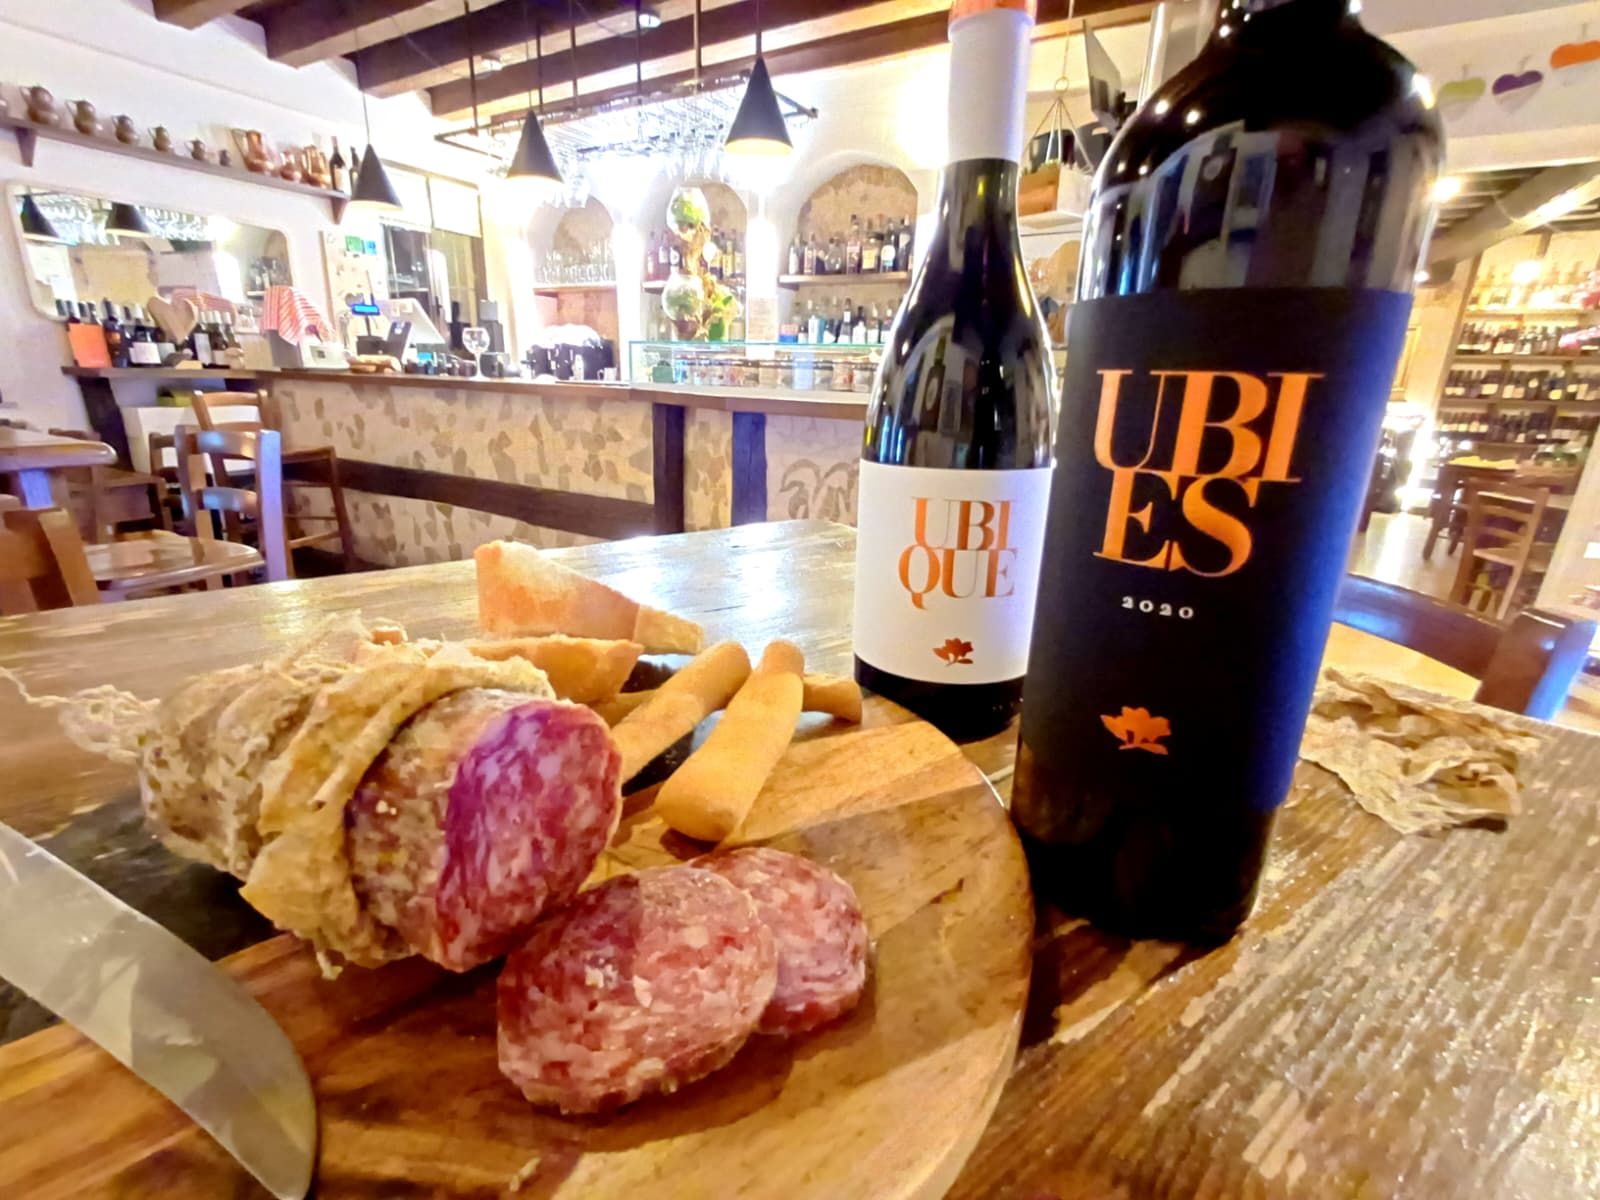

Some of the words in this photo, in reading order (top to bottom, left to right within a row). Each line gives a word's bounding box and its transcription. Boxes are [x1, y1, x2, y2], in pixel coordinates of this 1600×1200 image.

[1094, 369, 1325, 482] UBI
[911, 497, 1018, 550] UBI
[1093, 472, 1260, 577] ES
[898, 545, 1018, 610] QUE
[1121, 596, 1194, 619] 2020
